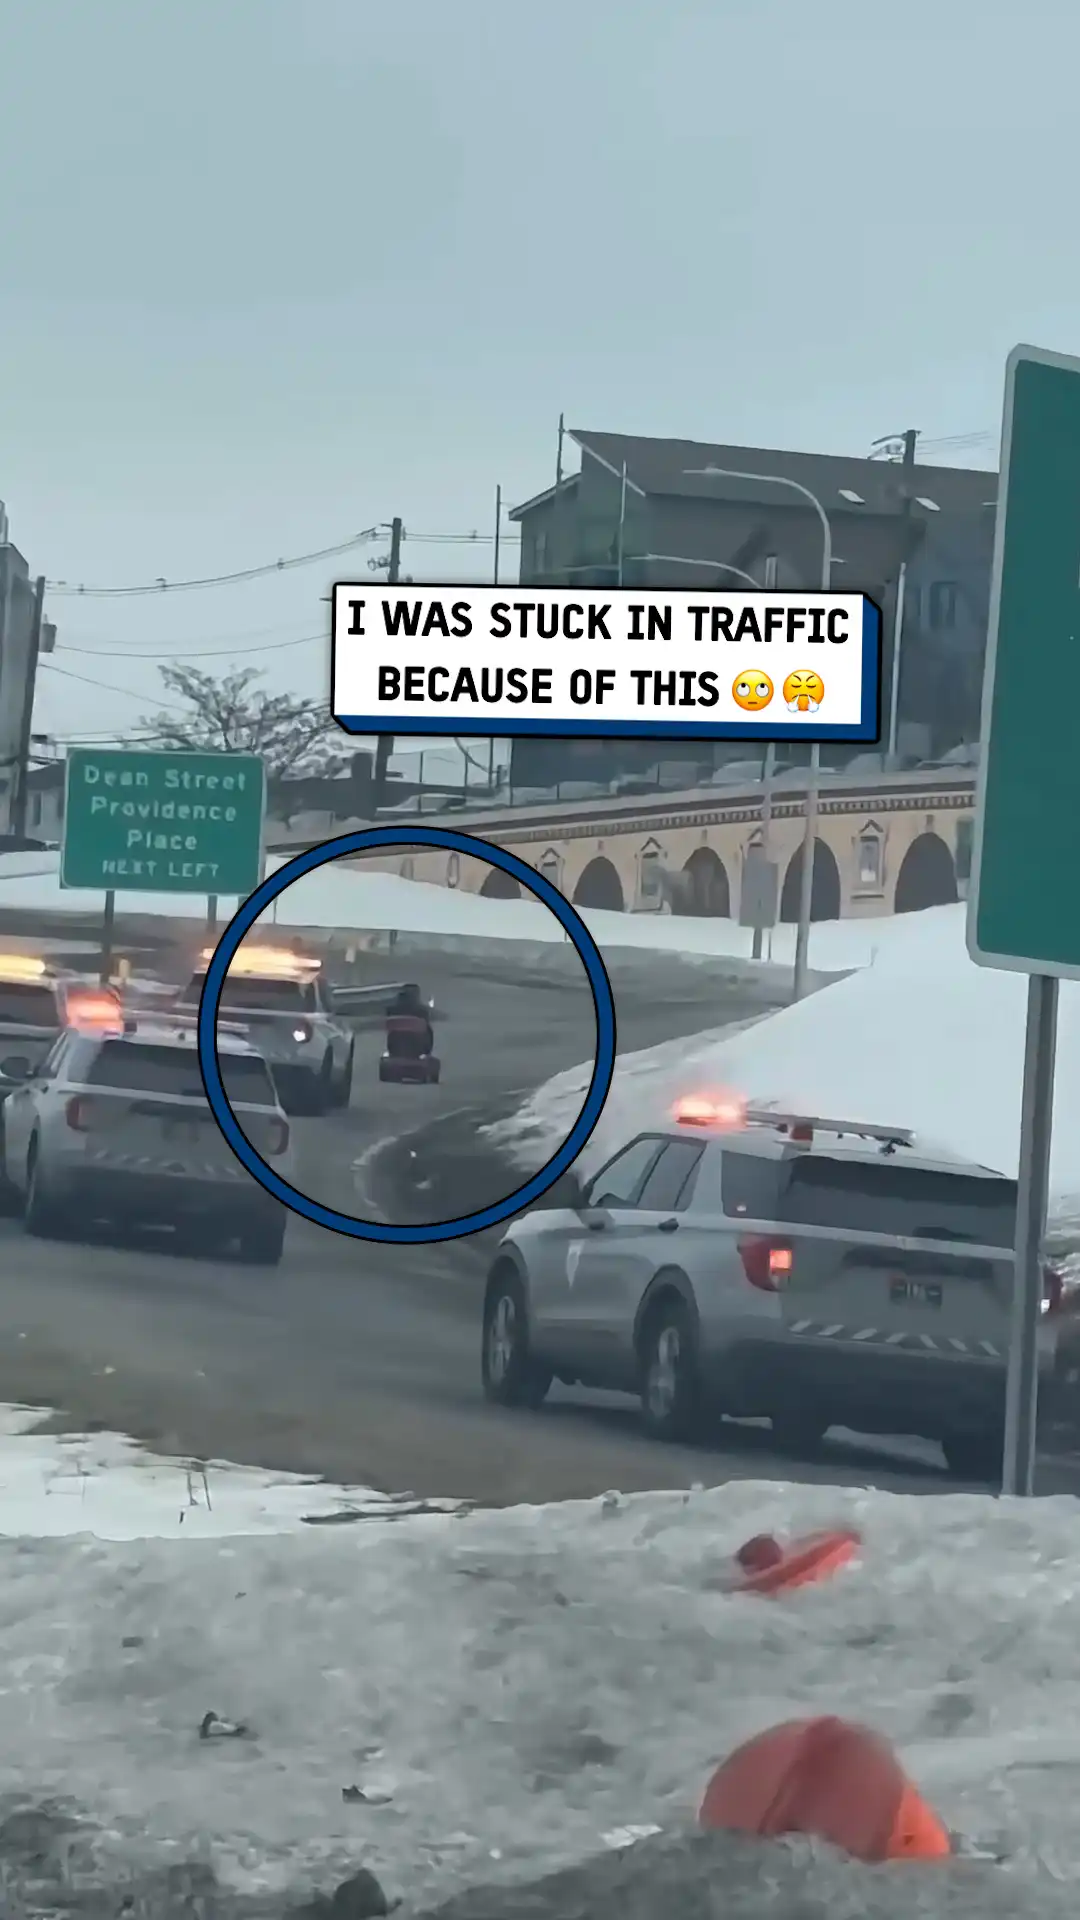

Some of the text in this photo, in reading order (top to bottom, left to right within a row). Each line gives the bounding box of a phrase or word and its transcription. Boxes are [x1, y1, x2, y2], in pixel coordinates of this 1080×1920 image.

[84, 765, 246, 791] Dean Street
[91, 796, 237, 821] Providence
[127, 829, 198, 850] Place
[102, 859, 220, 878] NEXT LEFT
